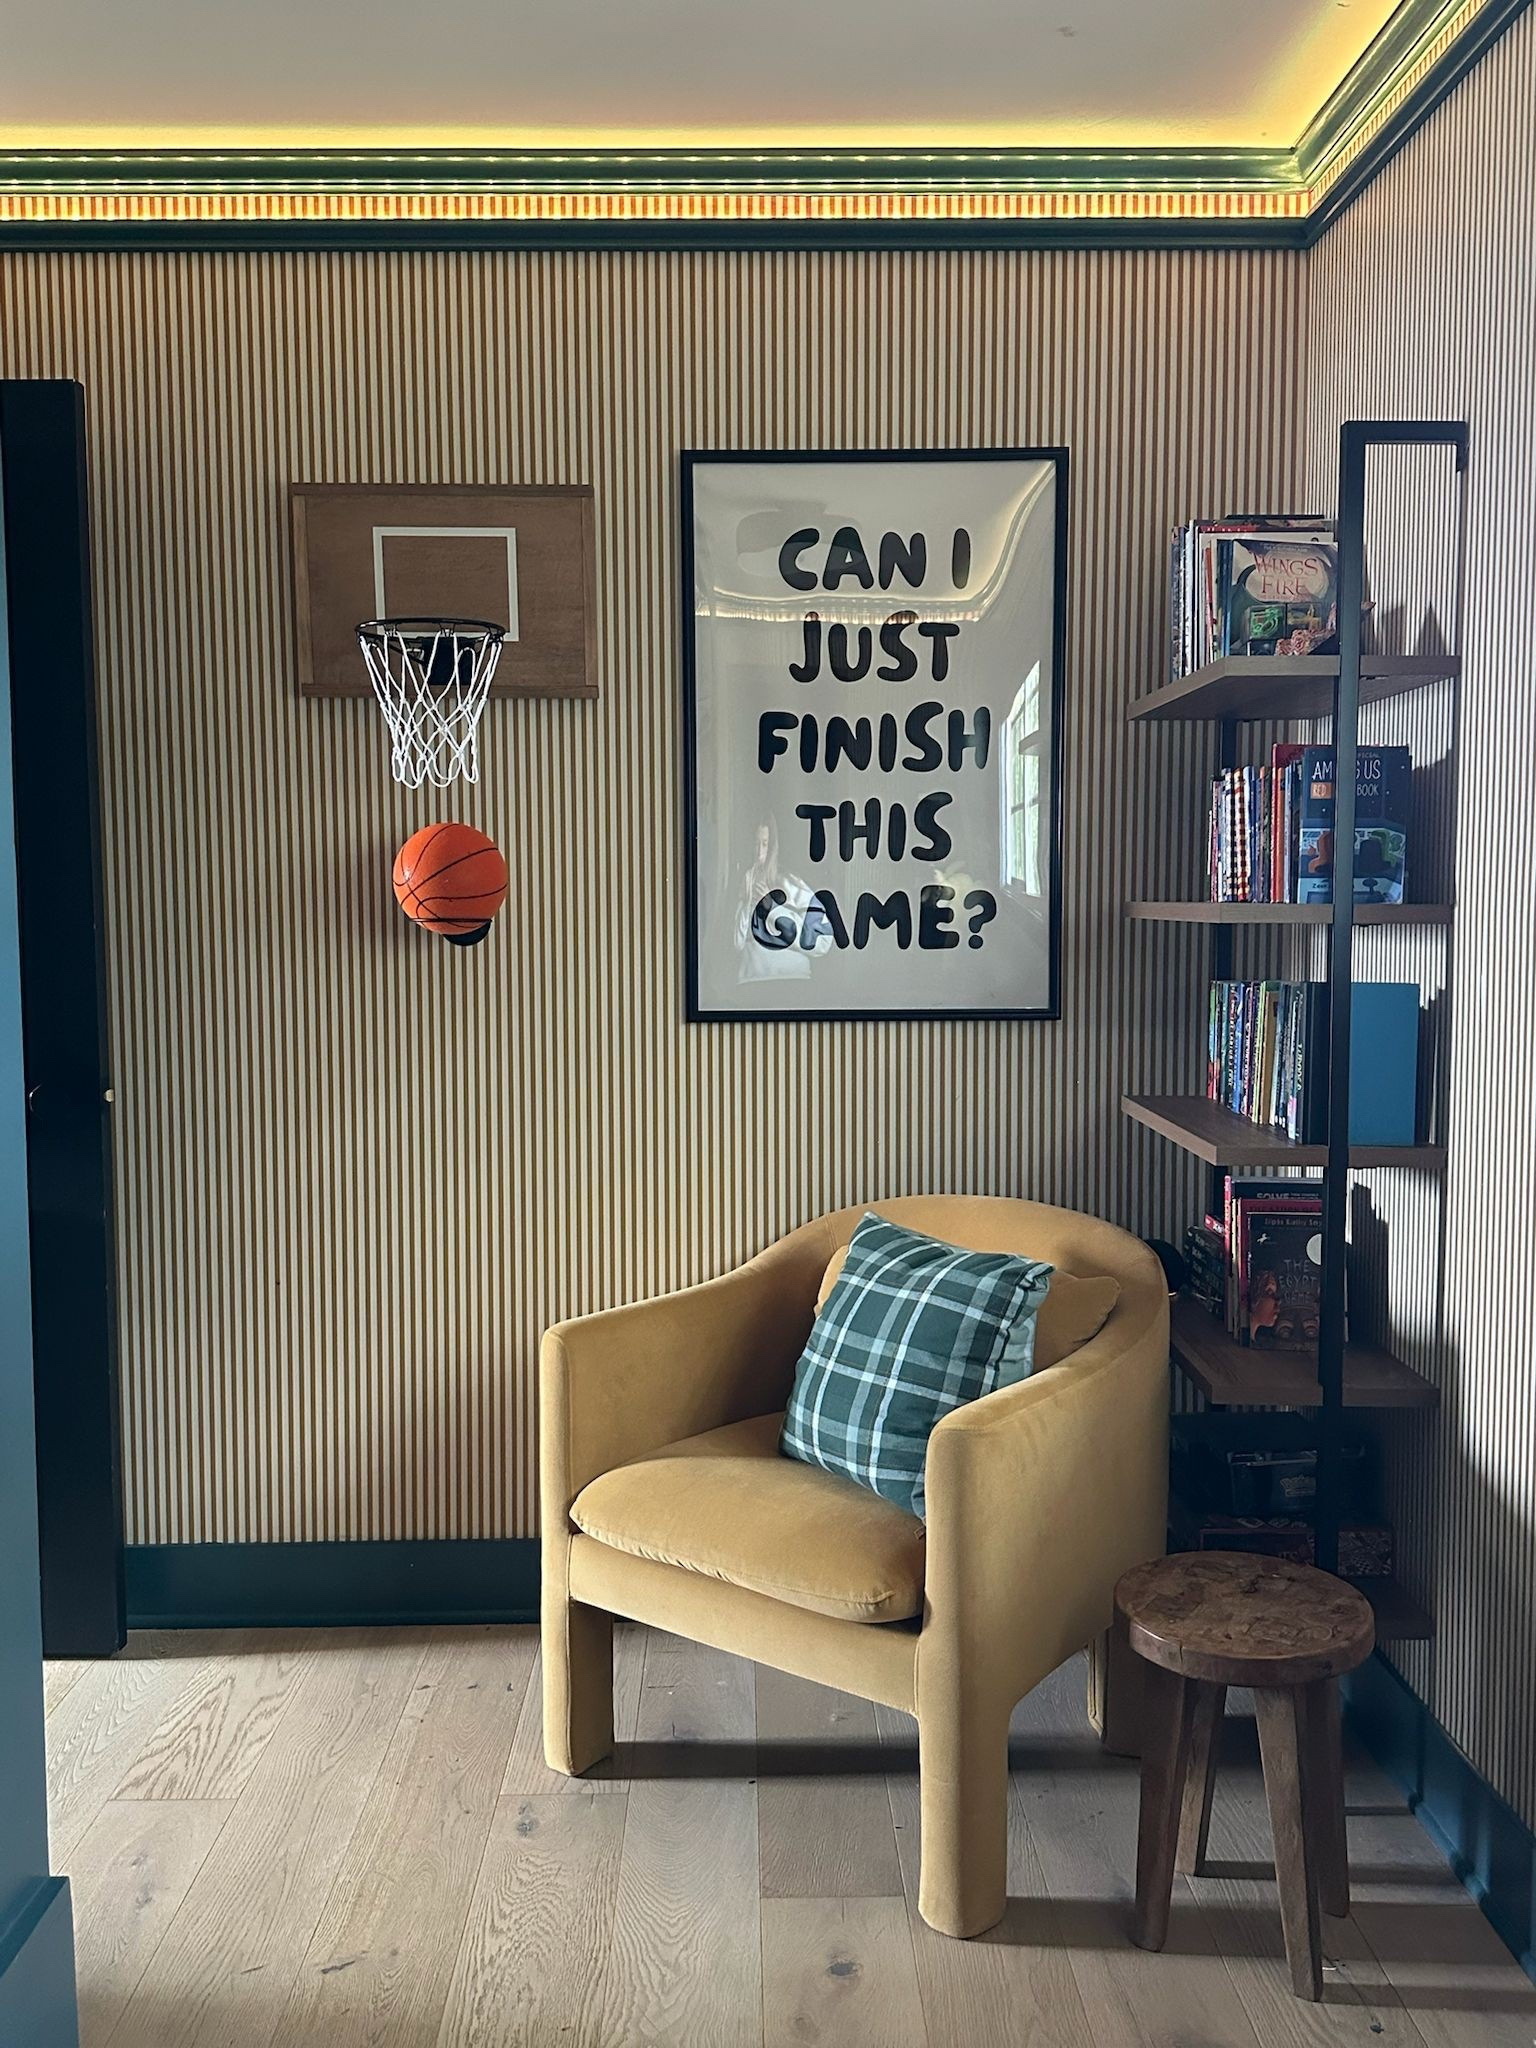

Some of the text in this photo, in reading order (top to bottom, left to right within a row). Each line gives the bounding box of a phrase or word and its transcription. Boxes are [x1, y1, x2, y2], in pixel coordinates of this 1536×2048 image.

[778, 527, 971, 591] CAN I
[1254, 553, 1318, 577] WINGS
[1262, 575, 1306, 595] FIRE
[788, 610, 960, 683] JUST
[757, 701, 991, 774] FINISH
[1364, 760, 1381, 780] US
[795, 791, 953, 863] THIS
[751, 885, 997, 950] GAME?
[1283, 1259, 1310, 1272] THE
